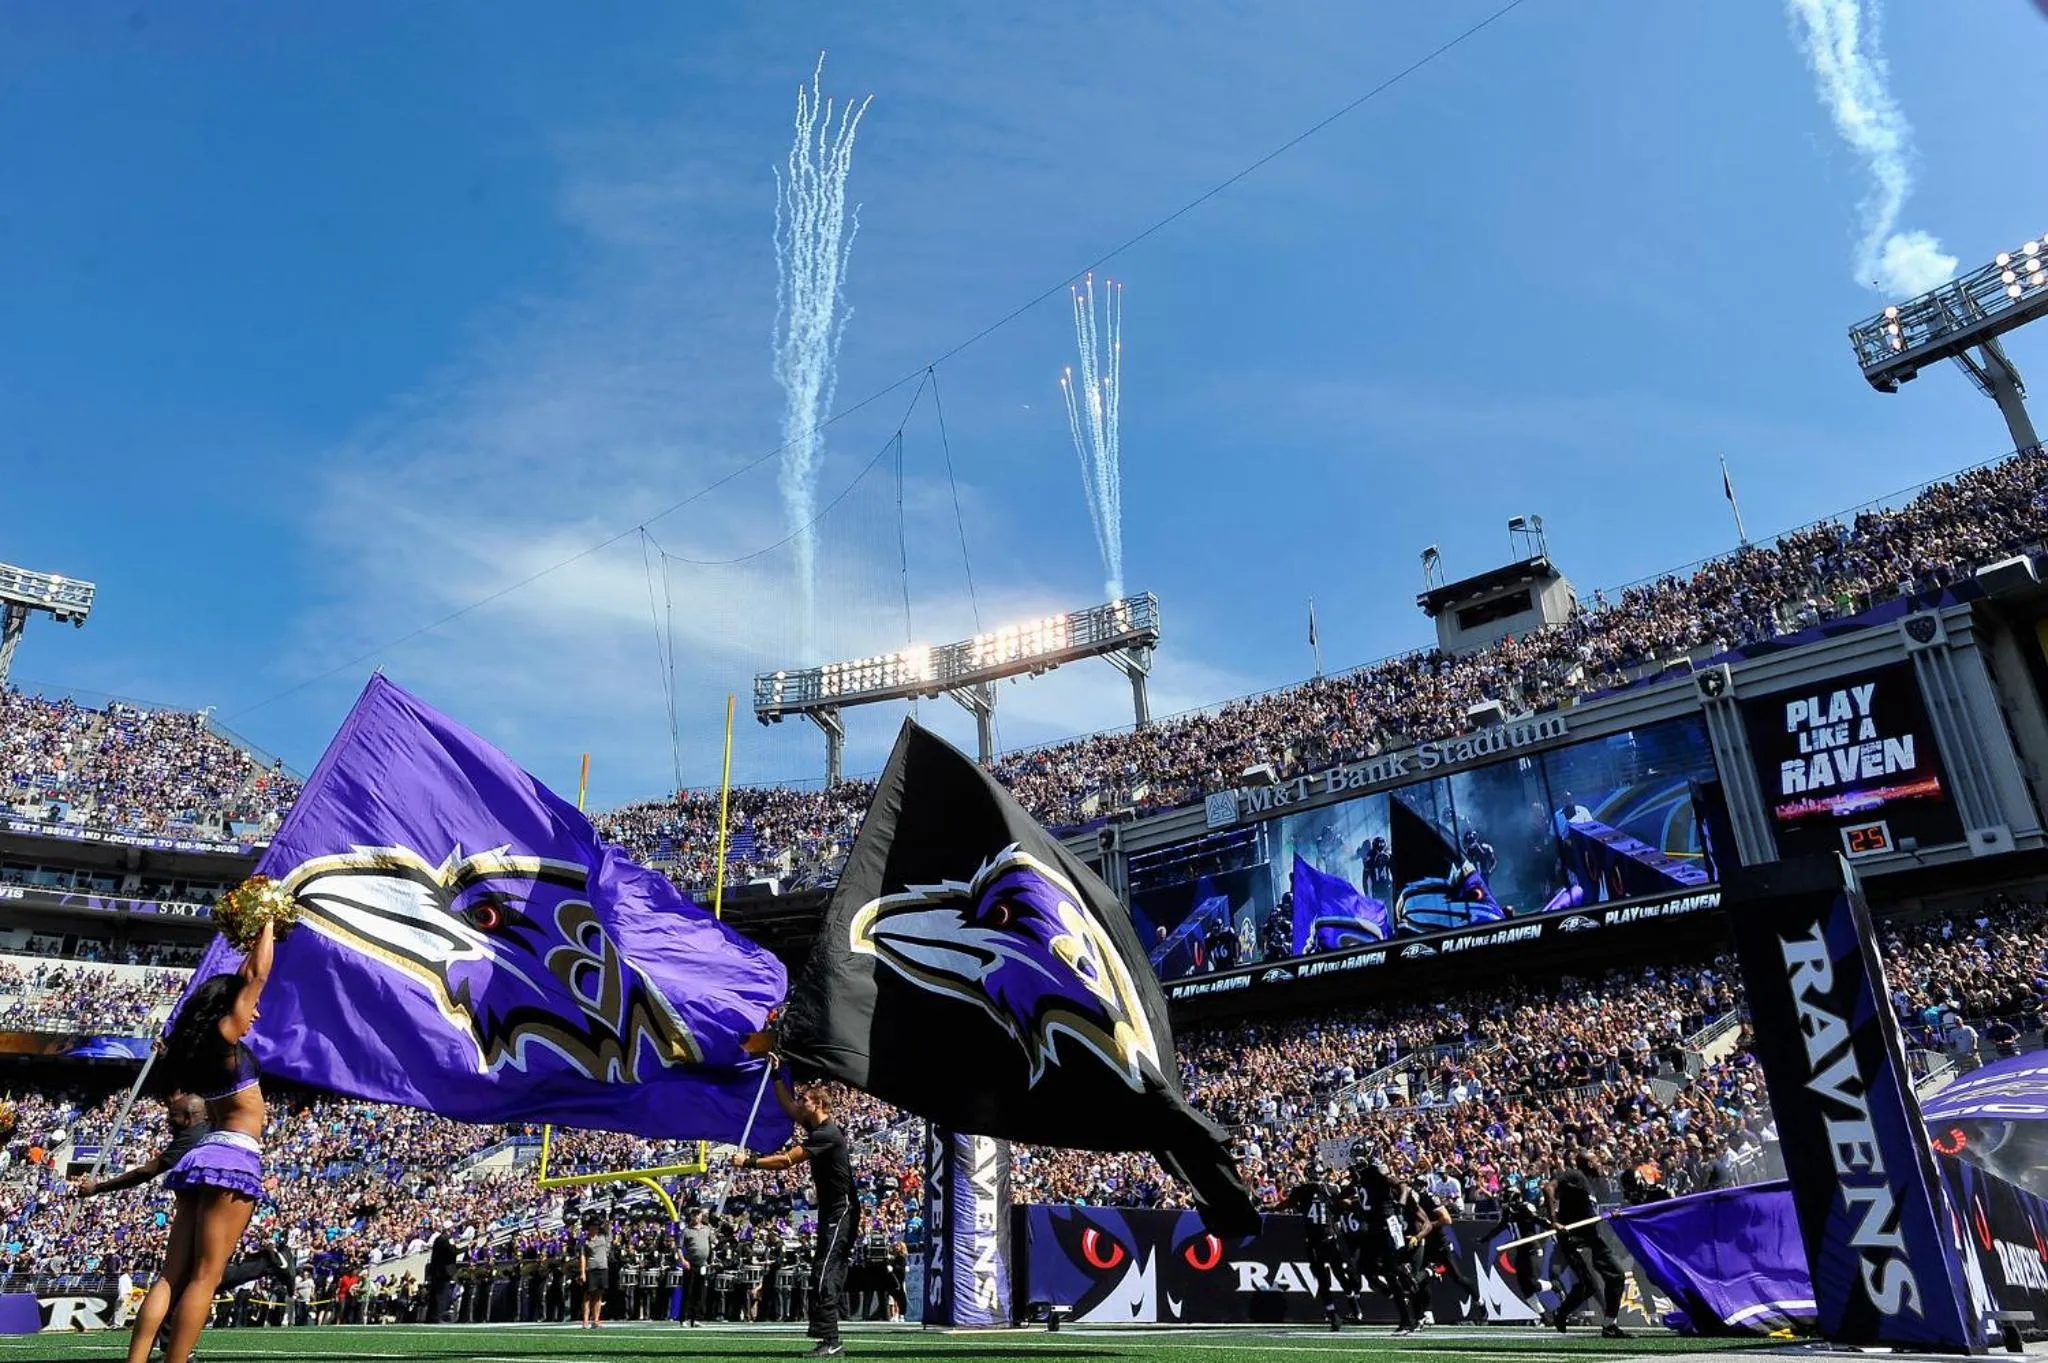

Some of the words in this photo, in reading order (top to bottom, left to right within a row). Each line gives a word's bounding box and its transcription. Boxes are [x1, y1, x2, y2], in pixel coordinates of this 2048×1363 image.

[1786, 683, 1875, 733] PLAY
[1800, 722, 1849, 754] LIKE
[1859, 717, 1877, 740] A
[1246, 776, 1311, 815] M&T
[1325, 751, 1410, 795] Bank
[1415, 716, 1570, 771] Stadium
[1781, 734, 1916, 795] RAVEN
[8, 821, 40, 833] TEXT
[42, 826, 76, 837] ISSUE
[78, 830, 101, 841] AND
[103, 833, 155, 847] LOCATION
[158, 839, 173, 848] TO
[1851, 827, 1885, 852] 25
[1605, 906, 1640, 926] PLAY
[1639, 904, 1660, 918] LIKE
[1662, 903, 1669, 914] A
[1669, 893, 1722, 914] RAVEN
[1441, 936, 1472, 953] PLAY
[1497, 924, 1542, 945] RAVEN
[1298, 961, 1324, 978] PLAY
[1347, 951, 1387, 970] RAVEN
[1172, 983, 1197, 999] PLAY
[1216, 975, 1251, 992] RAVEN
[1776, 920, 1926, 1319] RAVENS
[930, 1123, 944, 1307] AVENS
[971, 1135, 998, 1310] AVENS
[1307, 1202, 1327, 1225] 41
[1228, 1261, 1388, 1299] RAV
